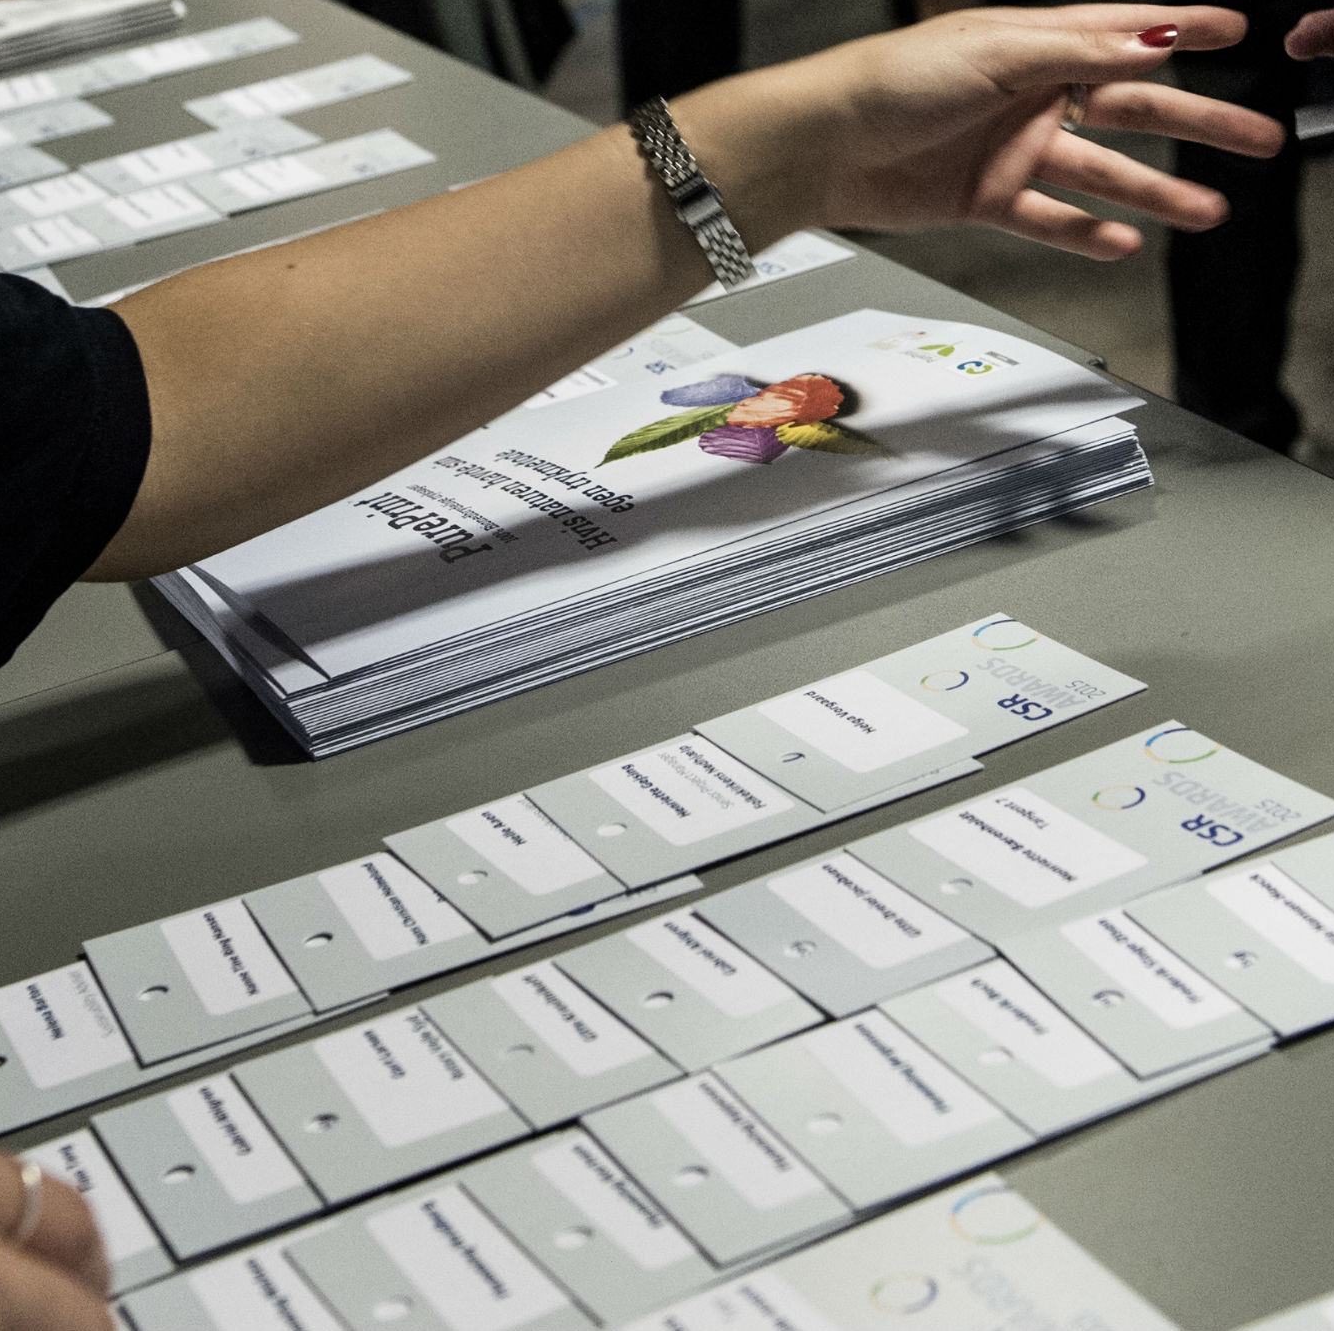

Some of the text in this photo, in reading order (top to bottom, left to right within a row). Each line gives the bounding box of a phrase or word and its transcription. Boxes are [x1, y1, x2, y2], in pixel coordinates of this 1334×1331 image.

[494, 448, 636, 514] egen trykmetode
[432, 455, 619, 551] Hvis naturen havde sin
[353, 491, 494, 564] PurePrint
[976, 657, 1087, 711] AWARDS
[1064, 679, 1107, 700] 2015
[803, 690, 876, 735] Helga Vorgaard
[997, 693, 1053, 722] CSR
[649, 786, 691, 819] Henriette
[1003, 801, 1048, 830] Tangent
[1151, 771, 1279, 833] AWARDS
[1253, 799, 1302, 823] 2015
[502, 829, 527, 846] Helle
[1180, 813, 1245, 847] CSR
[1021, 848, 1077, 883] Henriette
[386, 894, 417, 928] Christian
[202, 911, 260, 997] Hanne Tine Ring Hansen
[25, 983, 65, 1041] Helena Barton
